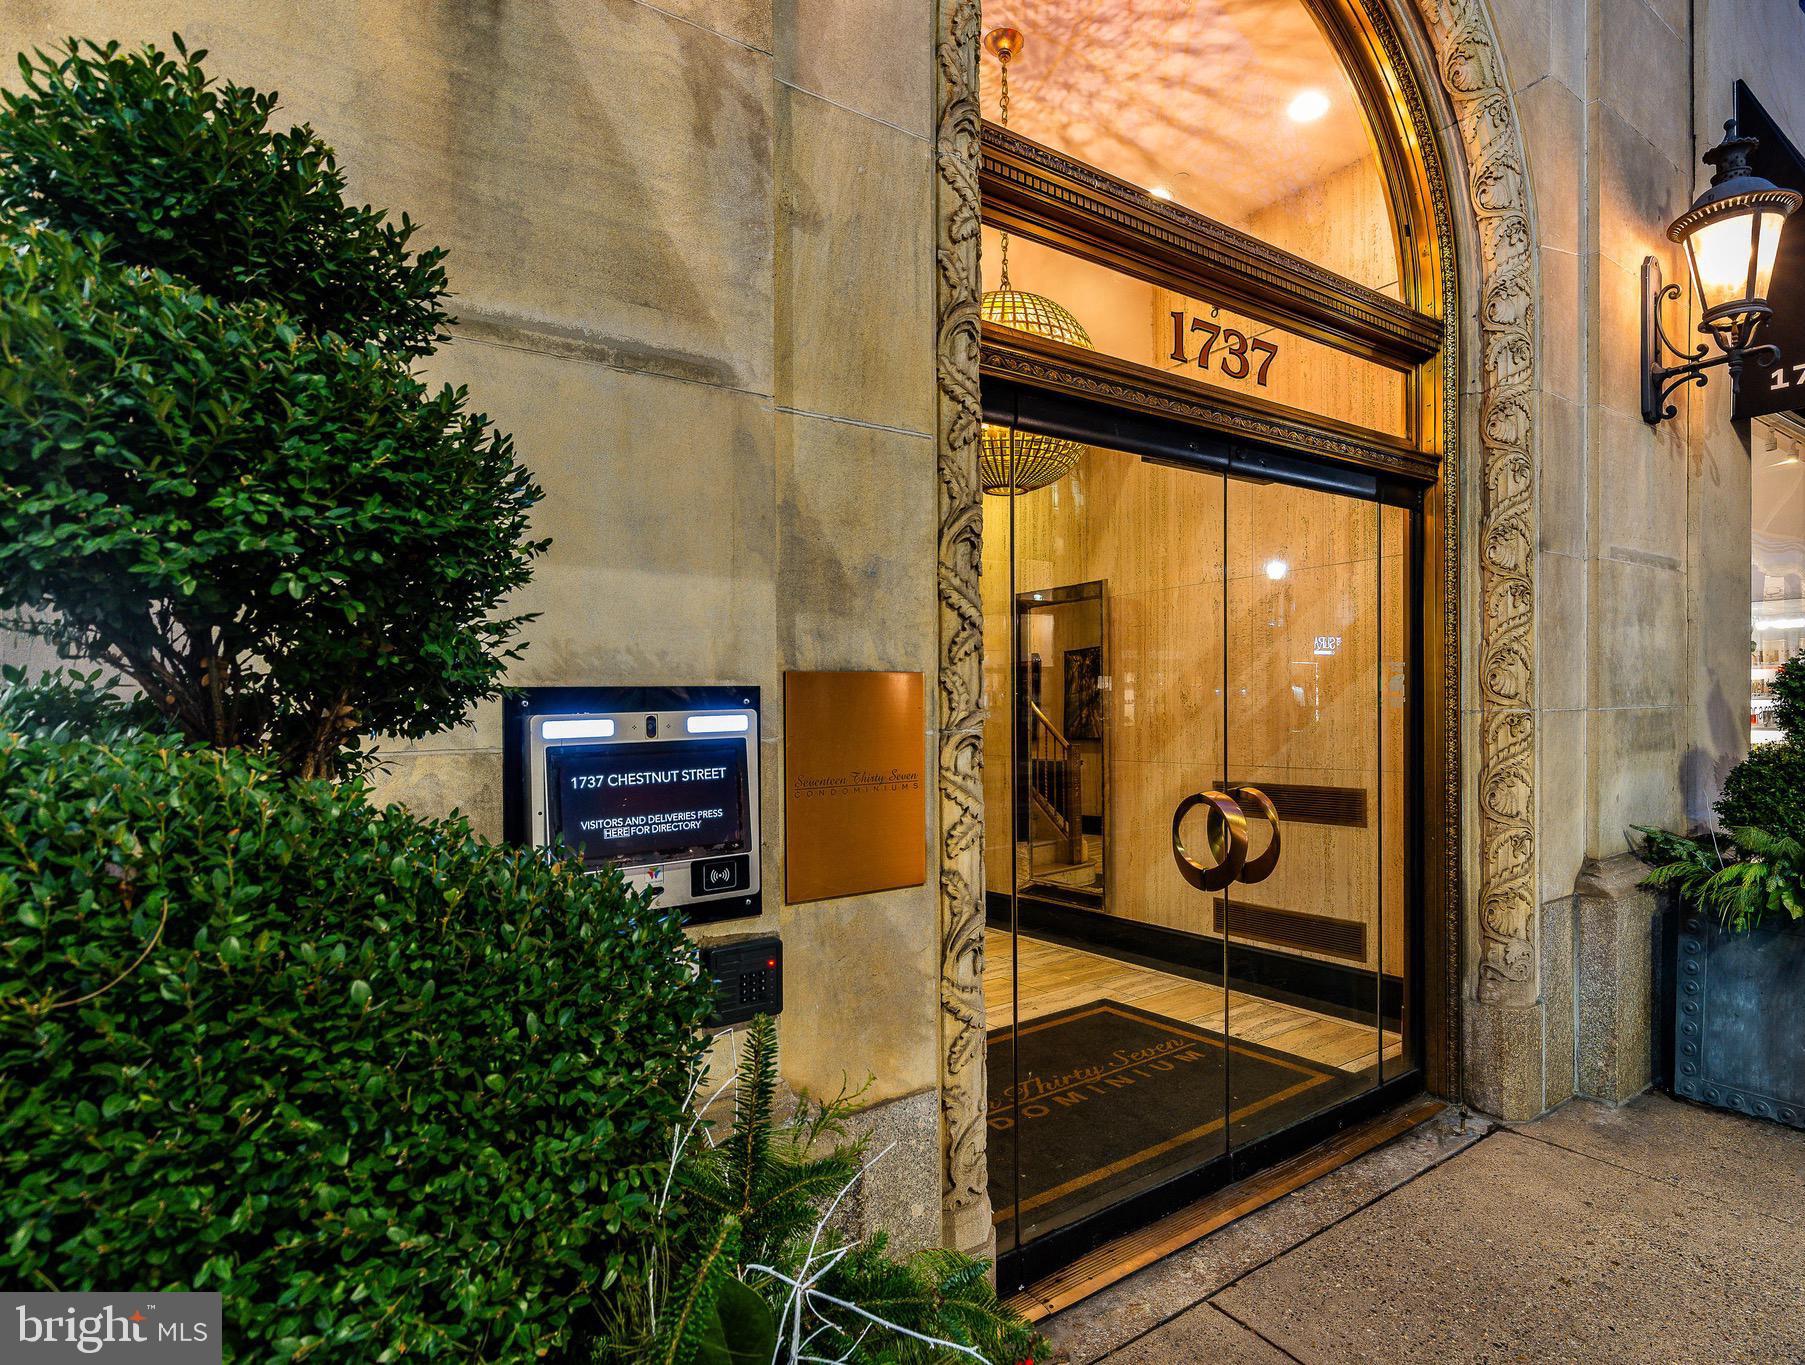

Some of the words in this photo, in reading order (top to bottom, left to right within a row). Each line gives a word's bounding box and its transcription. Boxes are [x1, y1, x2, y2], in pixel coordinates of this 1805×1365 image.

[1170, 311, 1279, 387] 1737
[570, 775, 604, 790] 1737
[607, 770, 680, 787] CHESTNUT
[681, 767, 727, 782] STREET
[888, 768, 919, 781] Seven
[794, 782, 919, 799] CONDOMINIUMS
[580, 817, 624, 831] VISITORS
[625, 815, 646, 826] AND
[648, 811, 696, 824] DELIVERIES
[697, 808, 723, 820] PRESS
[604, 827, 630, 839] HERE
[630, 825, 650, 836] FOR
[651, 820, 702, 834] DIRECTORY
[1003, 1064, 1105, 1100] Thirty
[1108, 1038, 1184, 1068] Seven
